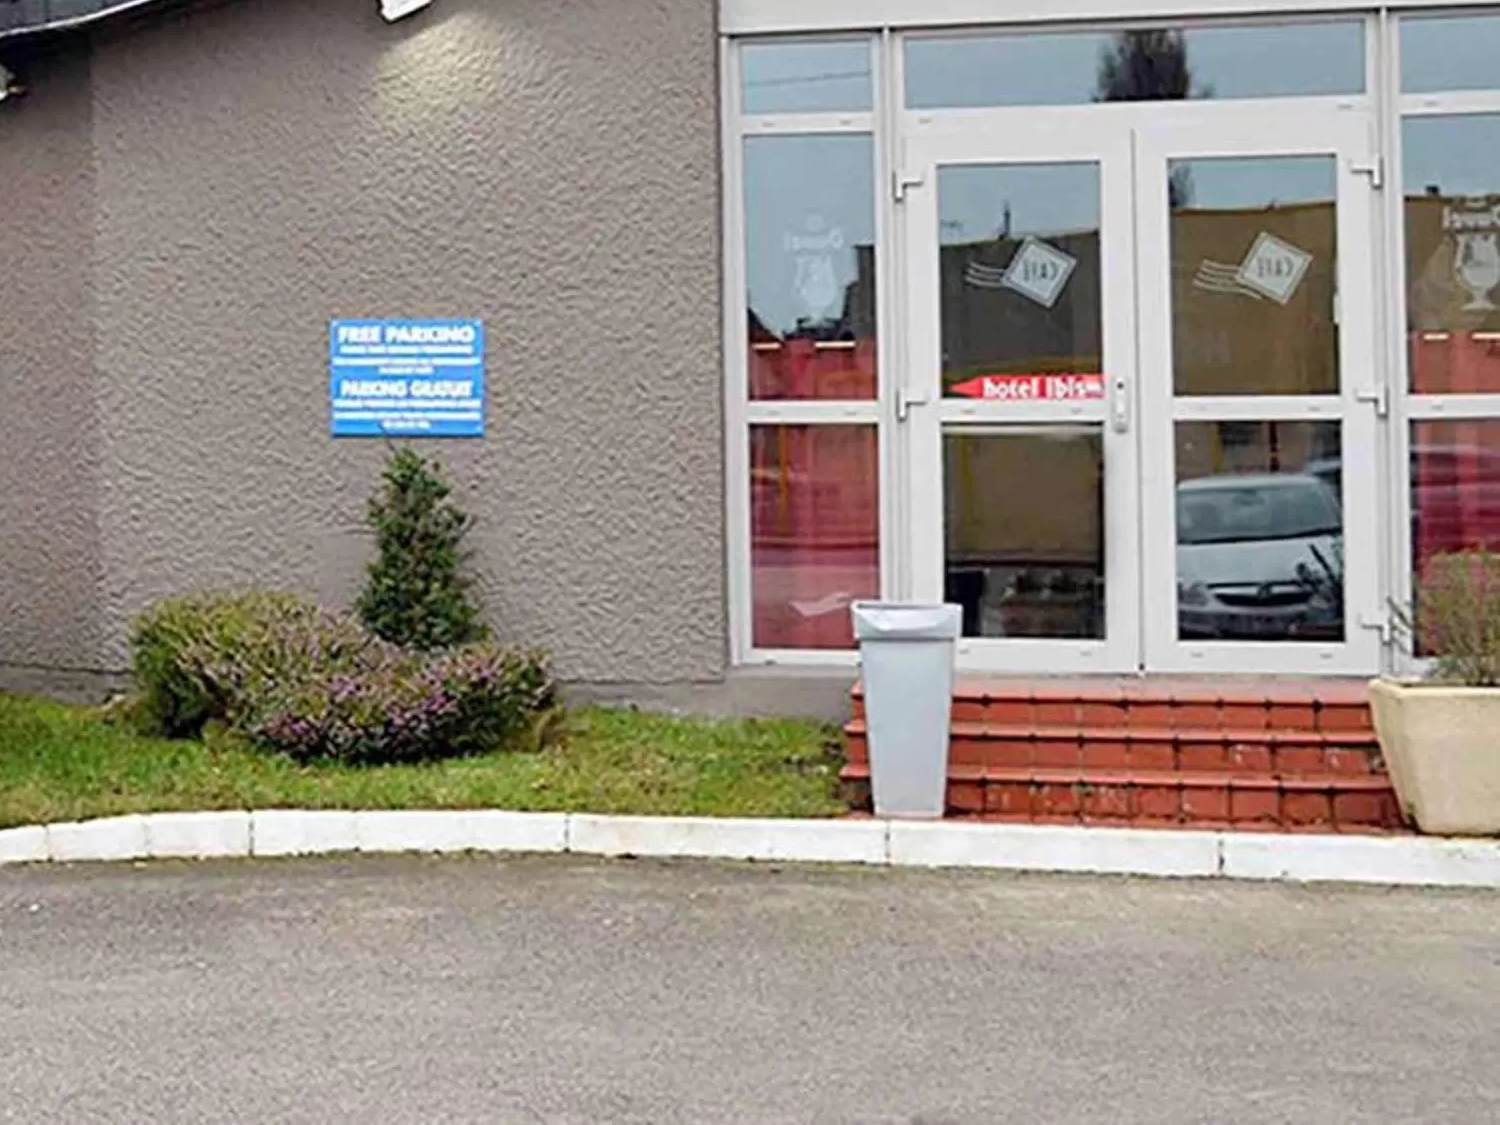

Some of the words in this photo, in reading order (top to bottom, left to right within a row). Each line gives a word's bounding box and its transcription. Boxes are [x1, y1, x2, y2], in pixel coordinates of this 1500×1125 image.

[338, 326, 381, 344] FREE
[384, 325, 476, 344] PARKING
[340, 379, 407, 398] PARKING
[410, 379, 474, 398] GRATUIT
[983, 376, 1039, 399] hotel
